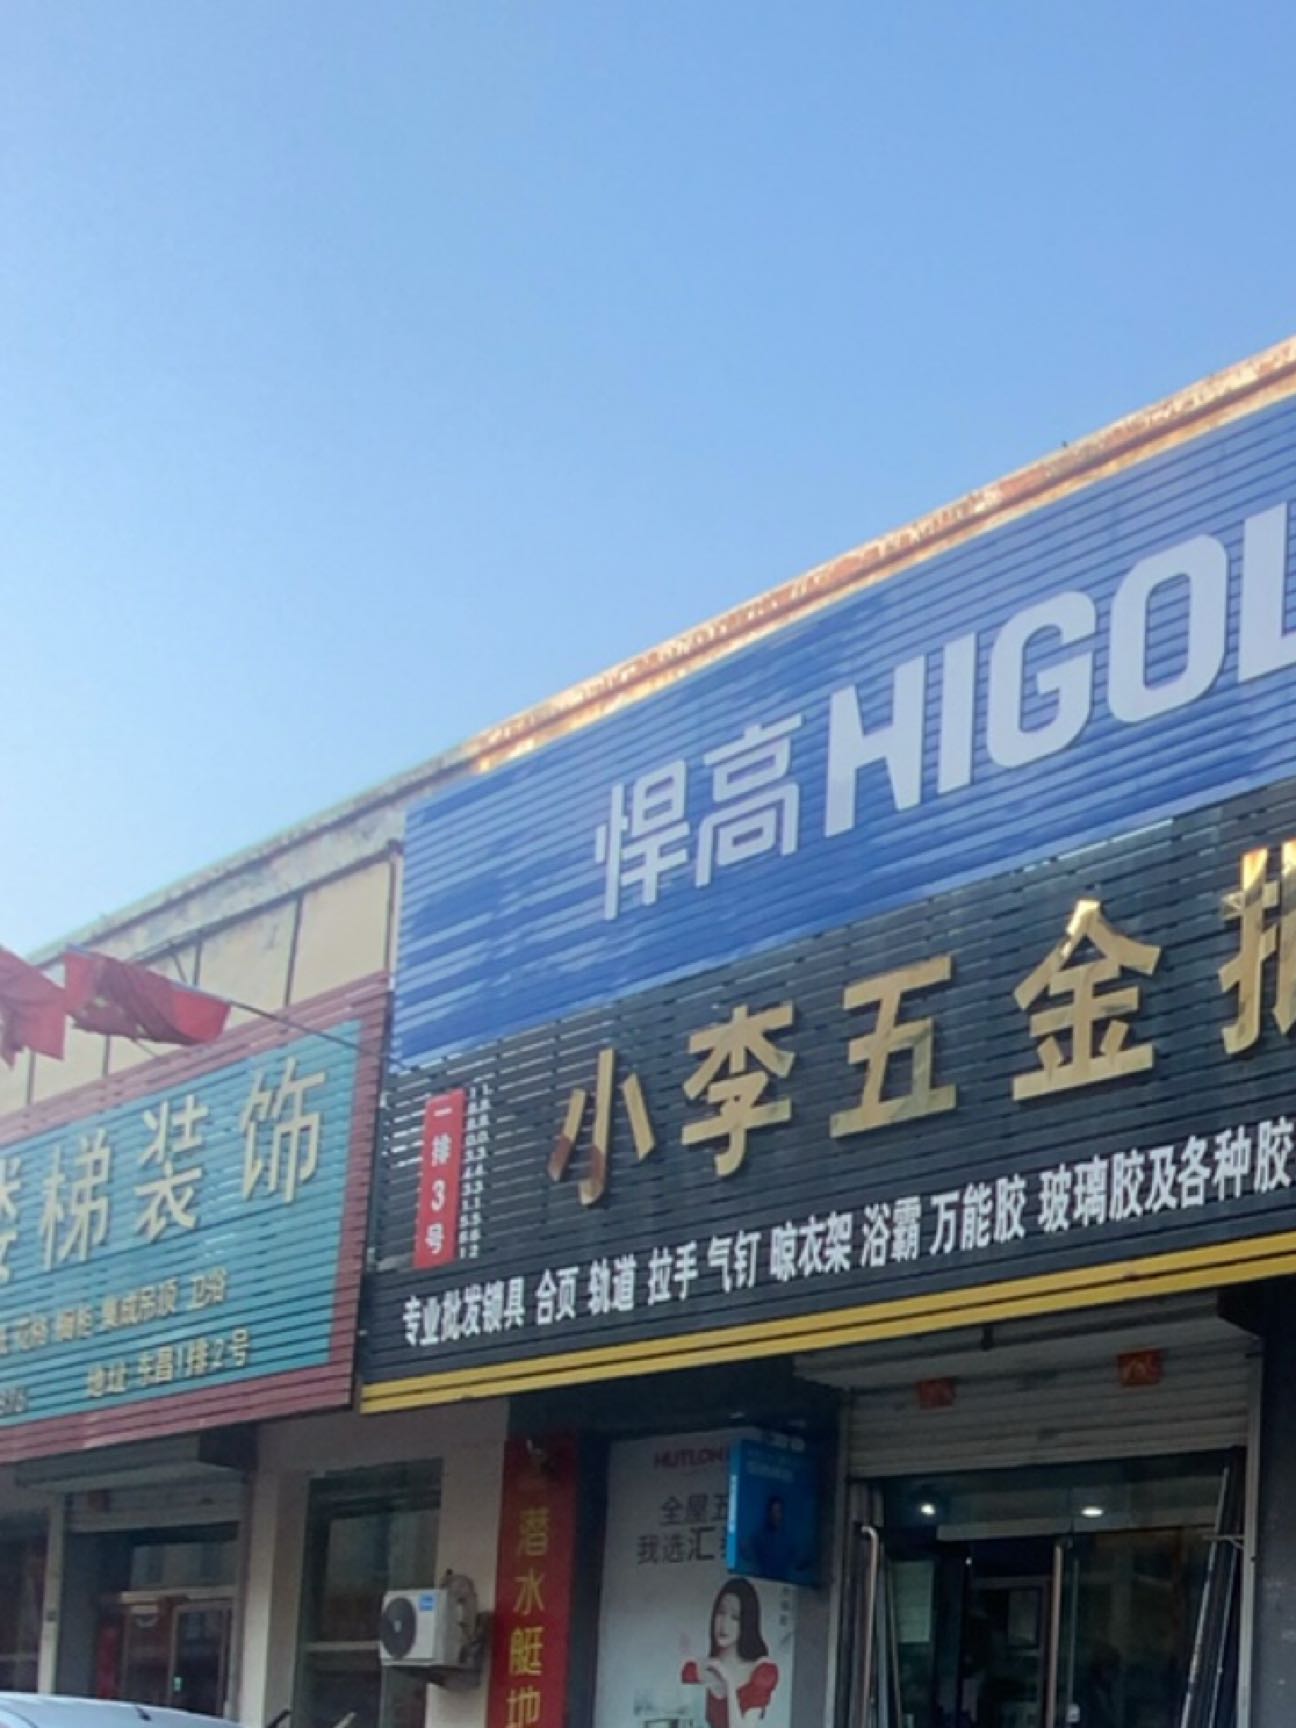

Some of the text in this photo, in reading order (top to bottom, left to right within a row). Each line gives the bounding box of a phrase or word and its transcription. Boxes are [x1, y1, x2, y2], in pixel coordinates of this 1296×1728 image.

[595, 711, 806, 921] 悍高
[402, 1276, 526, 1347] 专业批发锁具
[536, 1267, 580, 1326] 合页
[588, 1253, 637, 1316] 轨道
[648, 1240, 698, 1306] 拉手
[707, 1228, 762, 1293] 气钉
[769, 1209, 853, 1283] 晾衣架
[861, 1194, 922, 1268] 浴霸
[929, 1173, 1027, 1255] 万能胶
[425, 1106, 453, 1255] 一排3号
[636, 1526, 728, 1565] 我选汇
